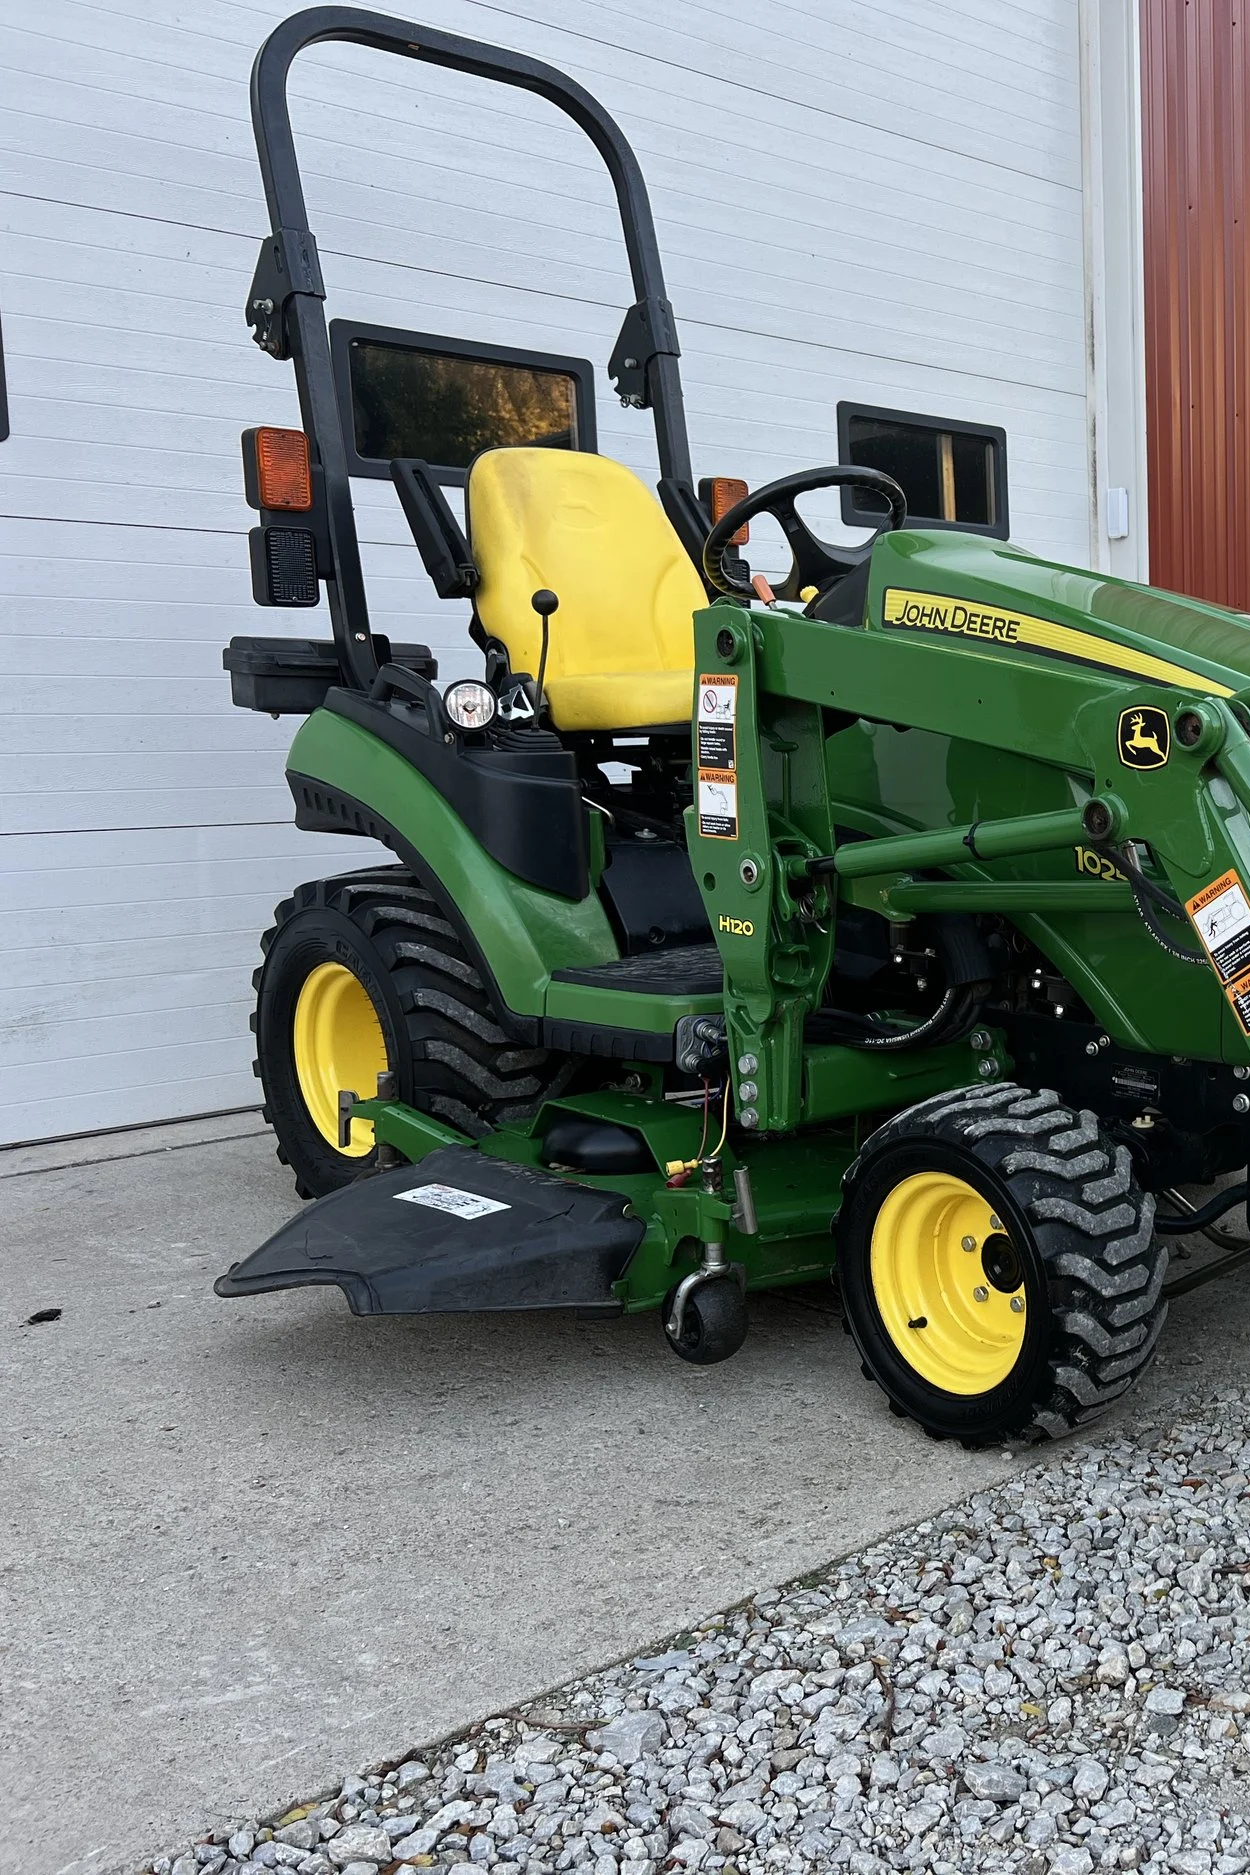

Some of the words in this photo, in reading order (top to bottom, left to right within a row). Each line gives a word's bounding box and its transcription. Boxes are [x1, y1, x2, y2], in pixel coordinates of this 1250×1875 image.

[895, 600, 948, 627] JOHN
[951, 606, 1020, 640] DEERE
[706, 677, 736, 686] WARNING
[705, 772, 735, 783] WARNING
[1075, 846, 1129, 881] 102
[1198, 877, 1232, 904] WARNING
[718, 914, 754, 937] H120
